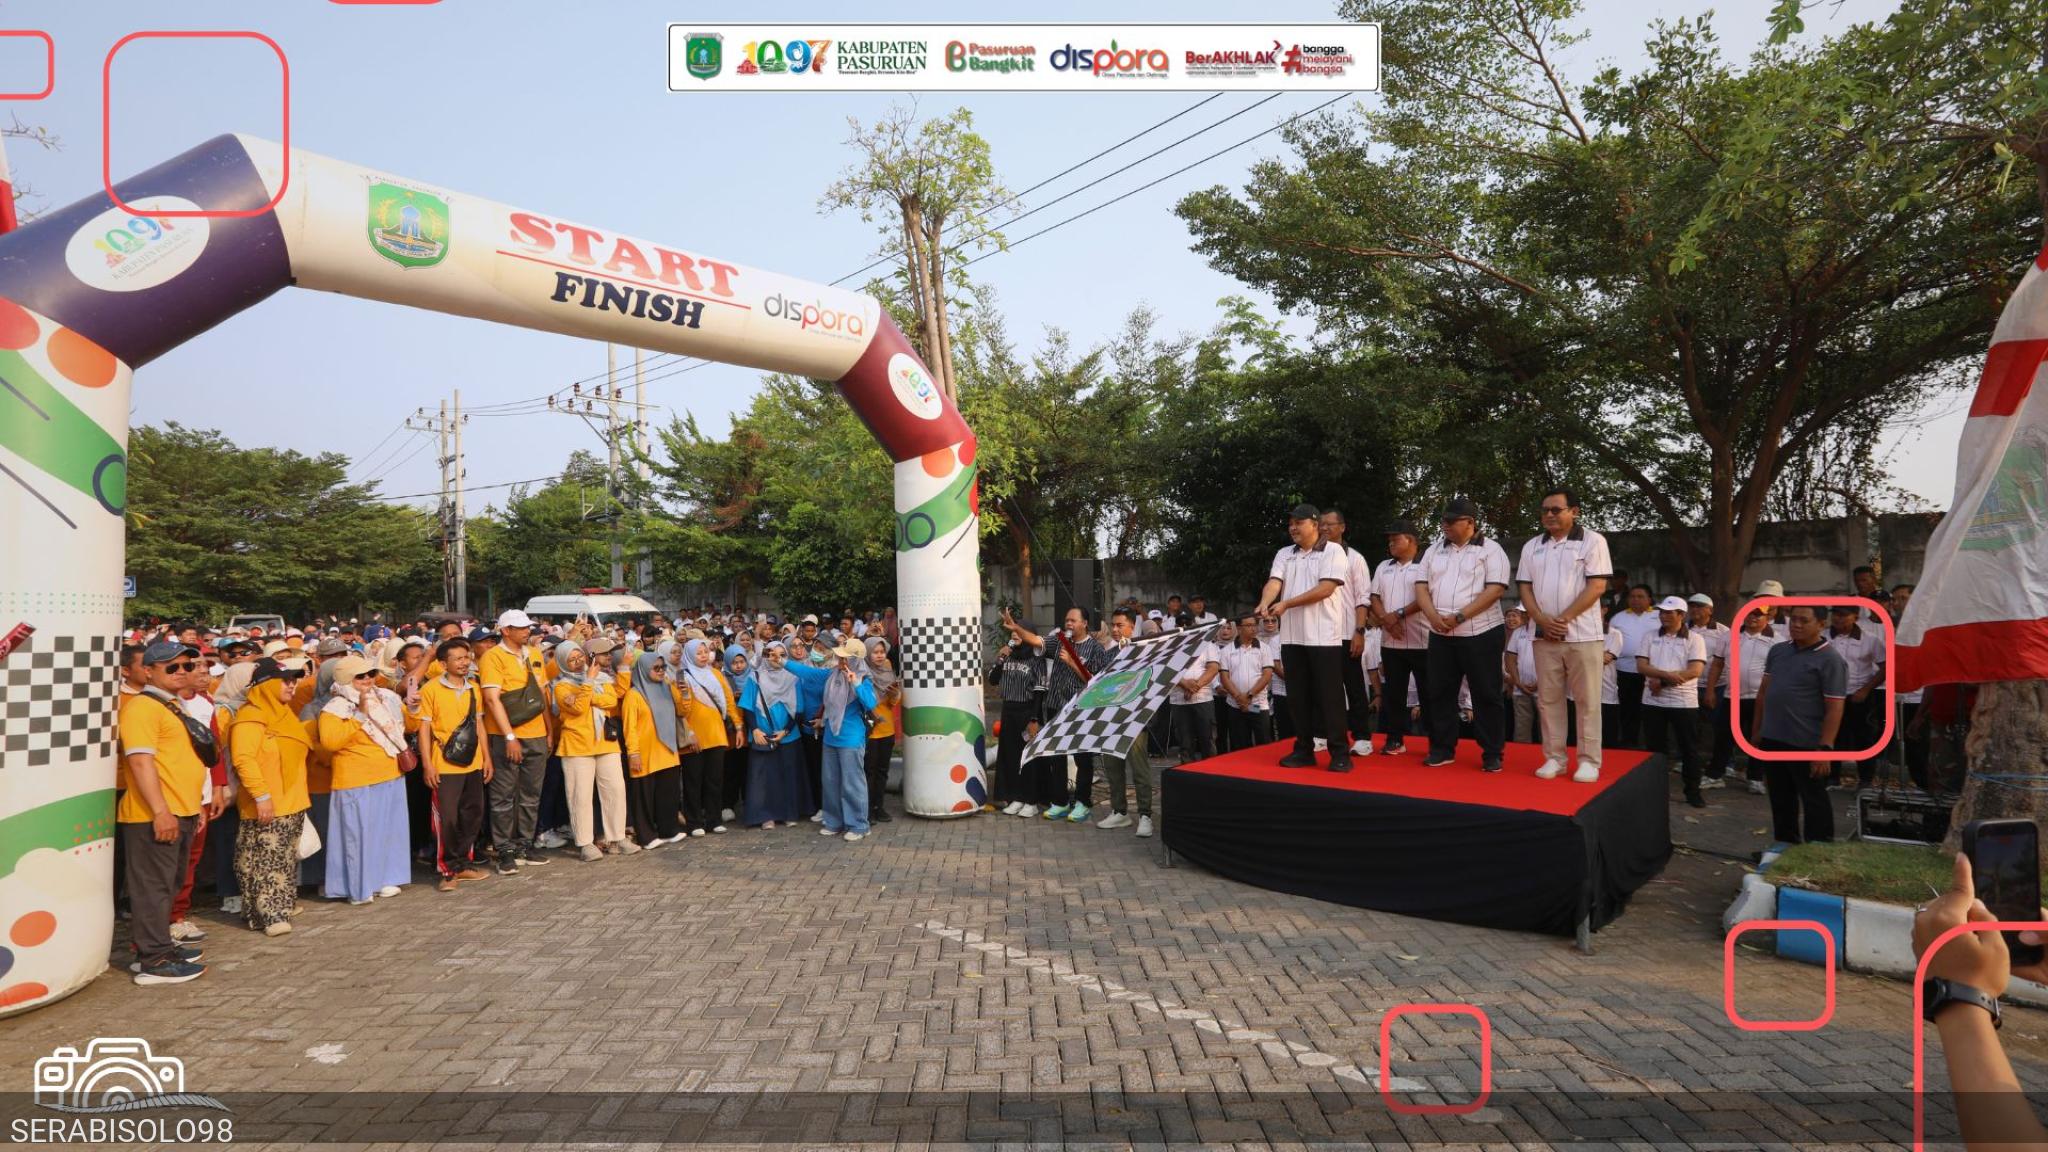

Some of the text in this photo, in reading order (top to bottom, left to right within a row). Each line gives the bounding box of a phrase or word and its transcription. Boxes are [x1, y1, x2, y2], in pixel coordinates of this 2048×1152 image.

[510, 212, 739, 297] START
[550, 271, 705, 329] FINISH
[764, 293, 862, 336] dispora
